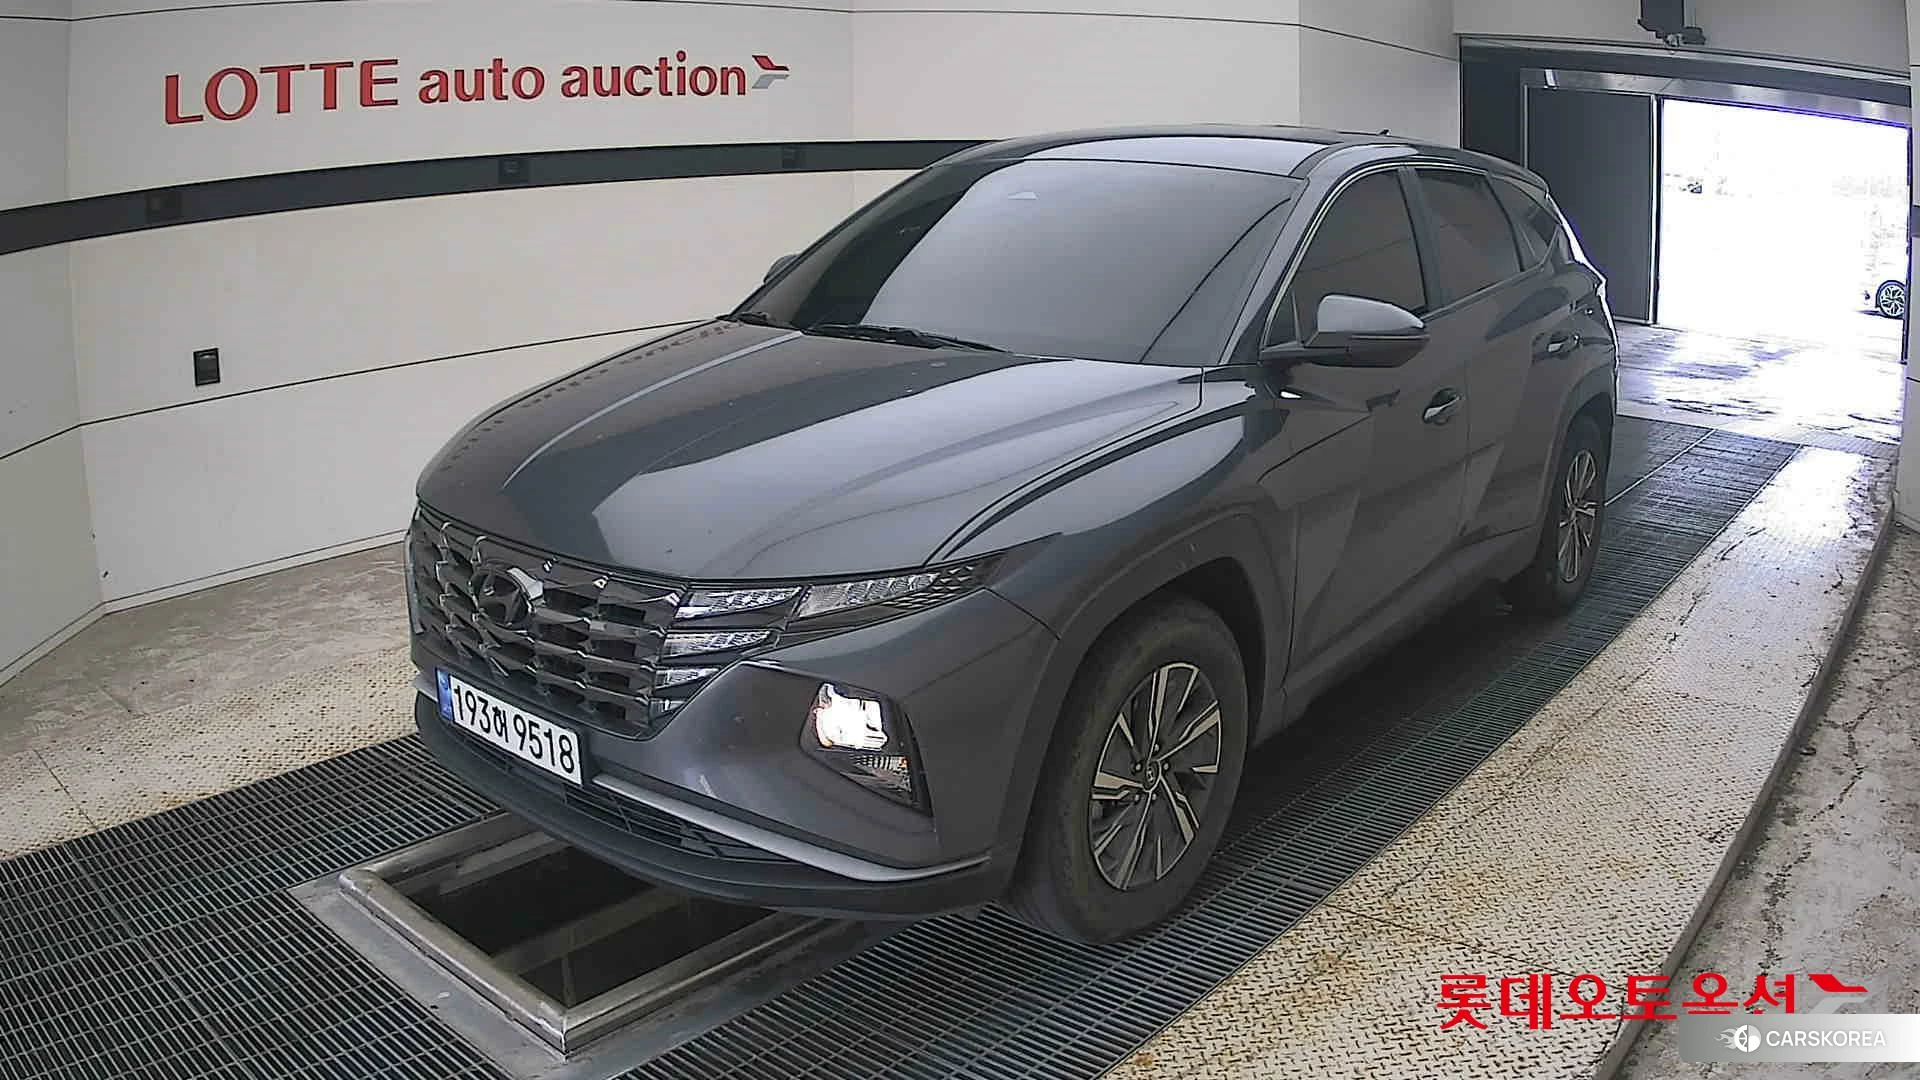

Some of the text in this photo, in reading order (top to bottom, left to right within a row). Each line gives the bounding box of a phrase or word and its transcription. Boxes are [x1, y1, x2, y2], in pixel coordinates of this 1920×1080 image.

[165, 50, 748, 125] LOTTE auto auction
[454, 685, 575, 774] 193허 9518
